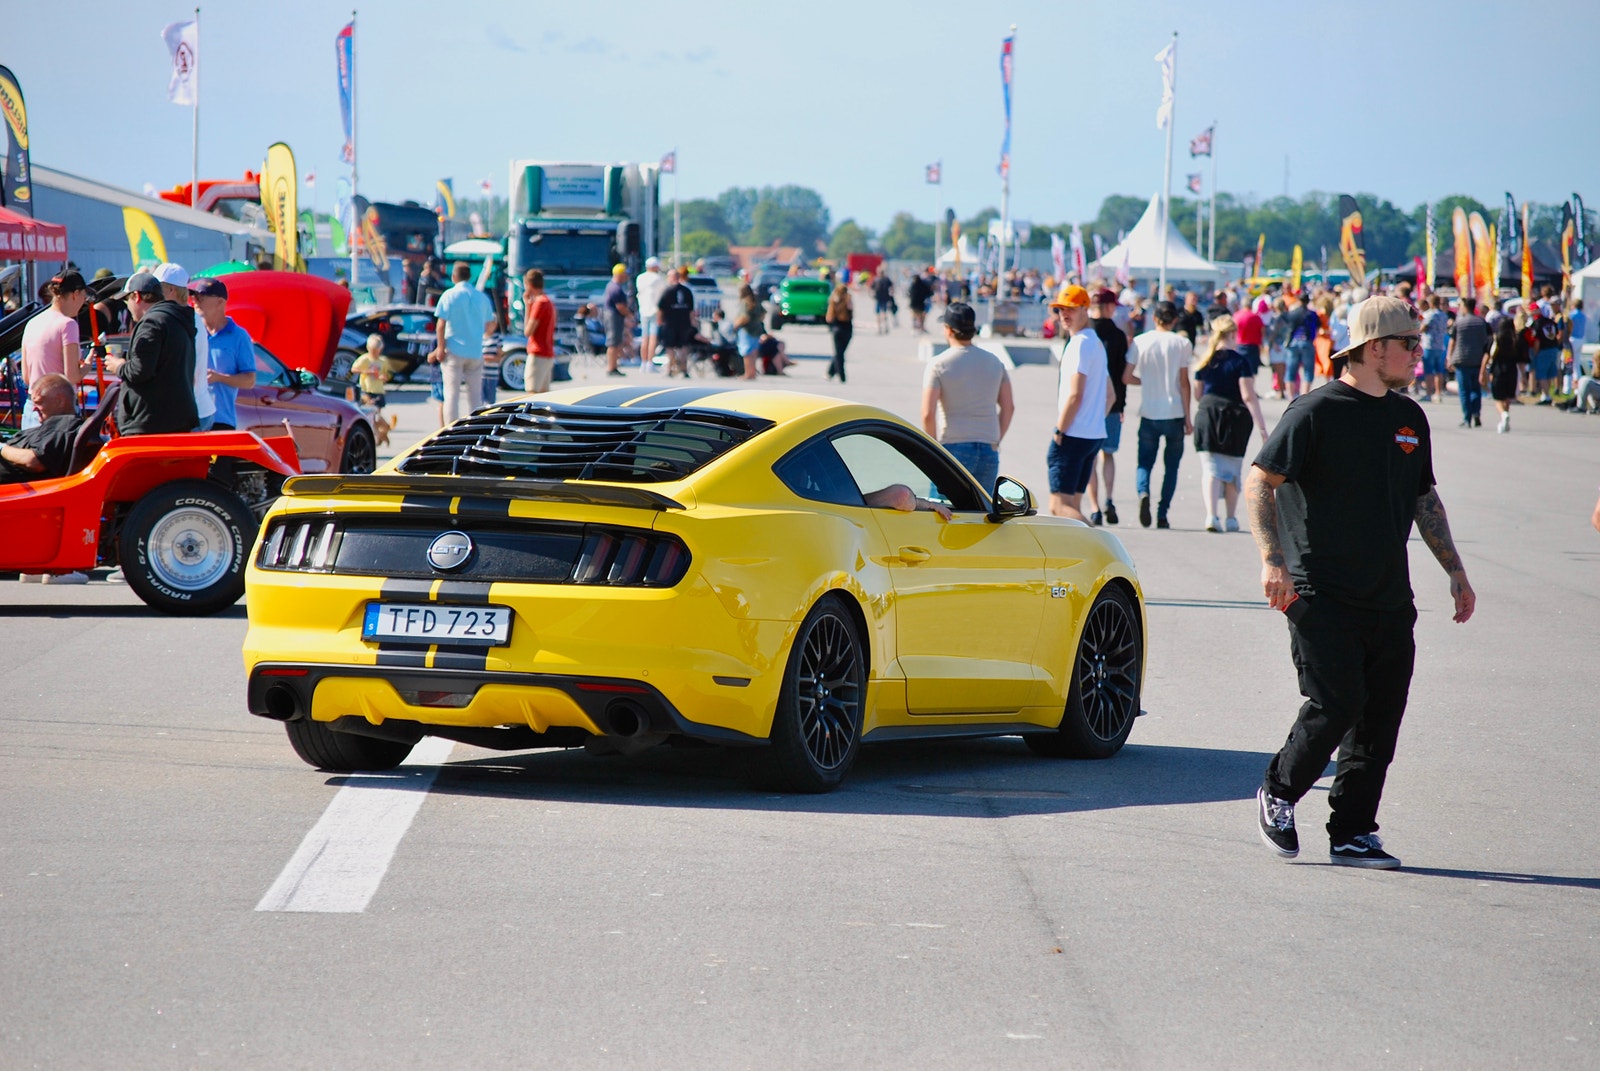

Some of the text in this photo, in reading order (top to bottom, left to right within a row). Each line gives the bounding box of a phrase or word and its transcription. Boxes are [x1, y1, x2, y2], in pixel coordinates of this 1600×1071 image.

[175, 498, 232, 521] COOPER
[231, 525, 243, 574] COBRA
[433, 545, 467, 555] GT
[146, 571, 192, 600] RADIAL
[368, 623, 374, 631] S
[389, 608, 496, 636] TFD 723
